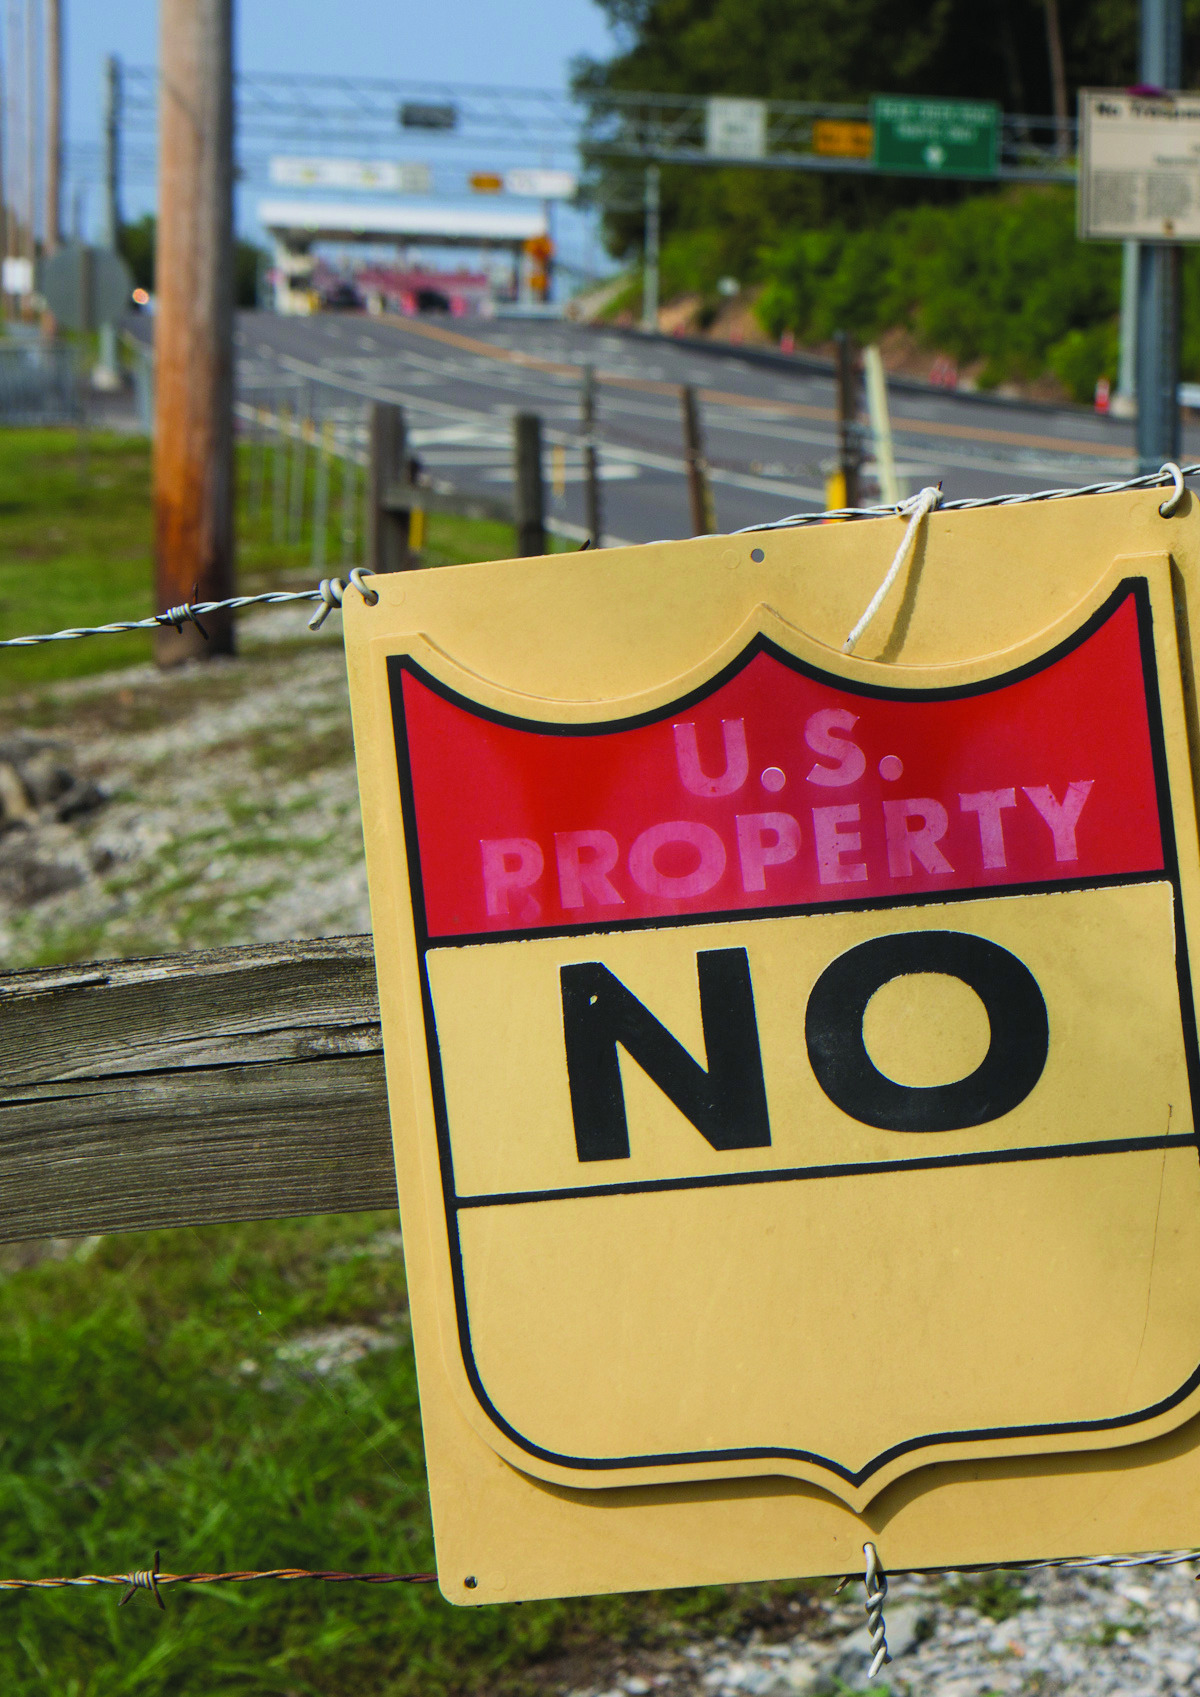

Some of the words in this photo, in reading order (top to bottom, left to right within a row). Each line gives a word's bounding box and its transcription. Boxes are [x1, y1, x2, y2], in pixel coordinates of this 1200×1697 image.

[673, 708, 903, 798] U.S.
[480, 780, 1095, 917] PROPERTY
[560, 930, 1049, 1162] NO
